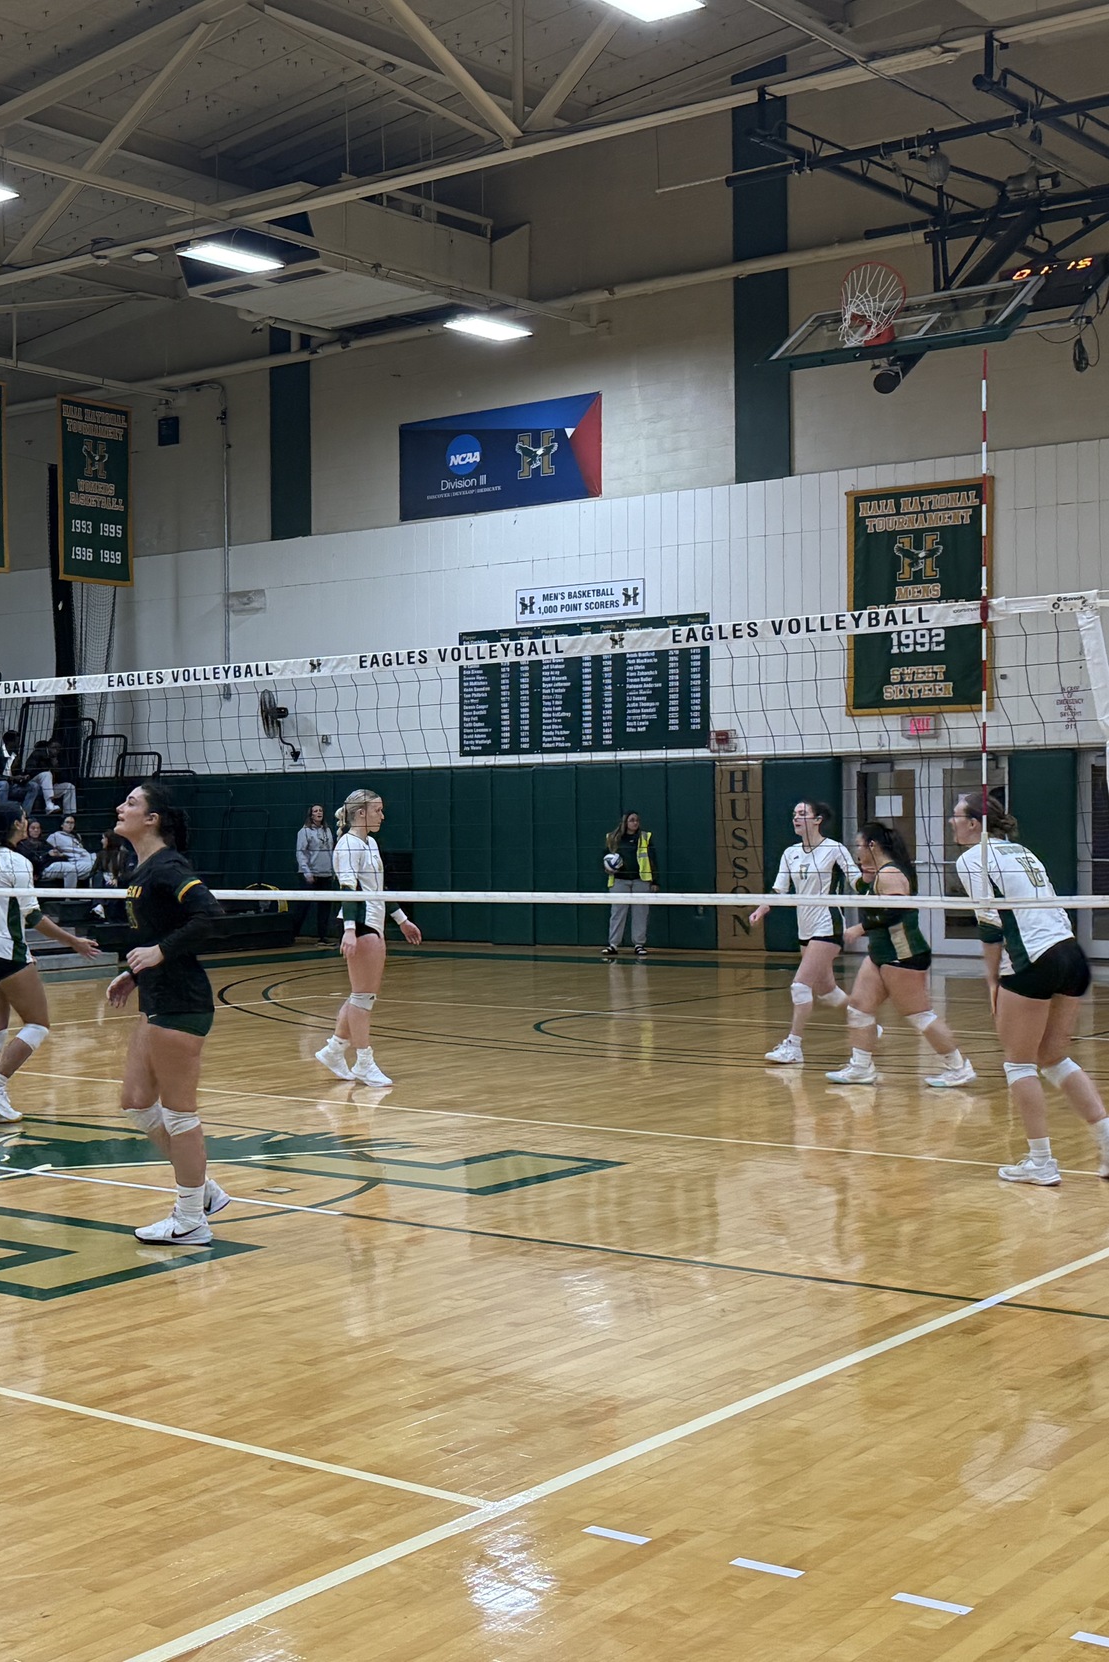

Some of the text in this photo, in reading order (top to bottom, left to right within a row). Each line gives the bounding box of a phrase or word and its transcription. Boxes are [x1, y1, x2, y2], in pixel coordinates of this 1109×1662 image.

[449, 451, 481, 467] NCAA
[441, 474, 487, 491] Division III
[859, 490, 980, 517] NAIA NATIONAL
[71, 519, 123, 538] 1993 1995
[865, 508, 973, 533] TOURNAMENT
[71, 546, 122, 565] 1996 1999
[542, 591, 566, 602] MEN'S
[567, 587, 615, 600] BASKETBALL
[895, 583, 941, 602] MENS
[537, 599, 620, 616] 1,000 POINT SCORERS
[671, 606, 931, 644] EAGLES VOLLEYBALL
[890, 628, 946, 654] 1992
[359, 639, 565, 669] EAGLES VOLLEYBALL
[107, 662, 274, 688] EAGLES VOLLEYBALL
[890, 665, 947, 683] SWEET
[883, 682, 954, 700] SIXTEEN
